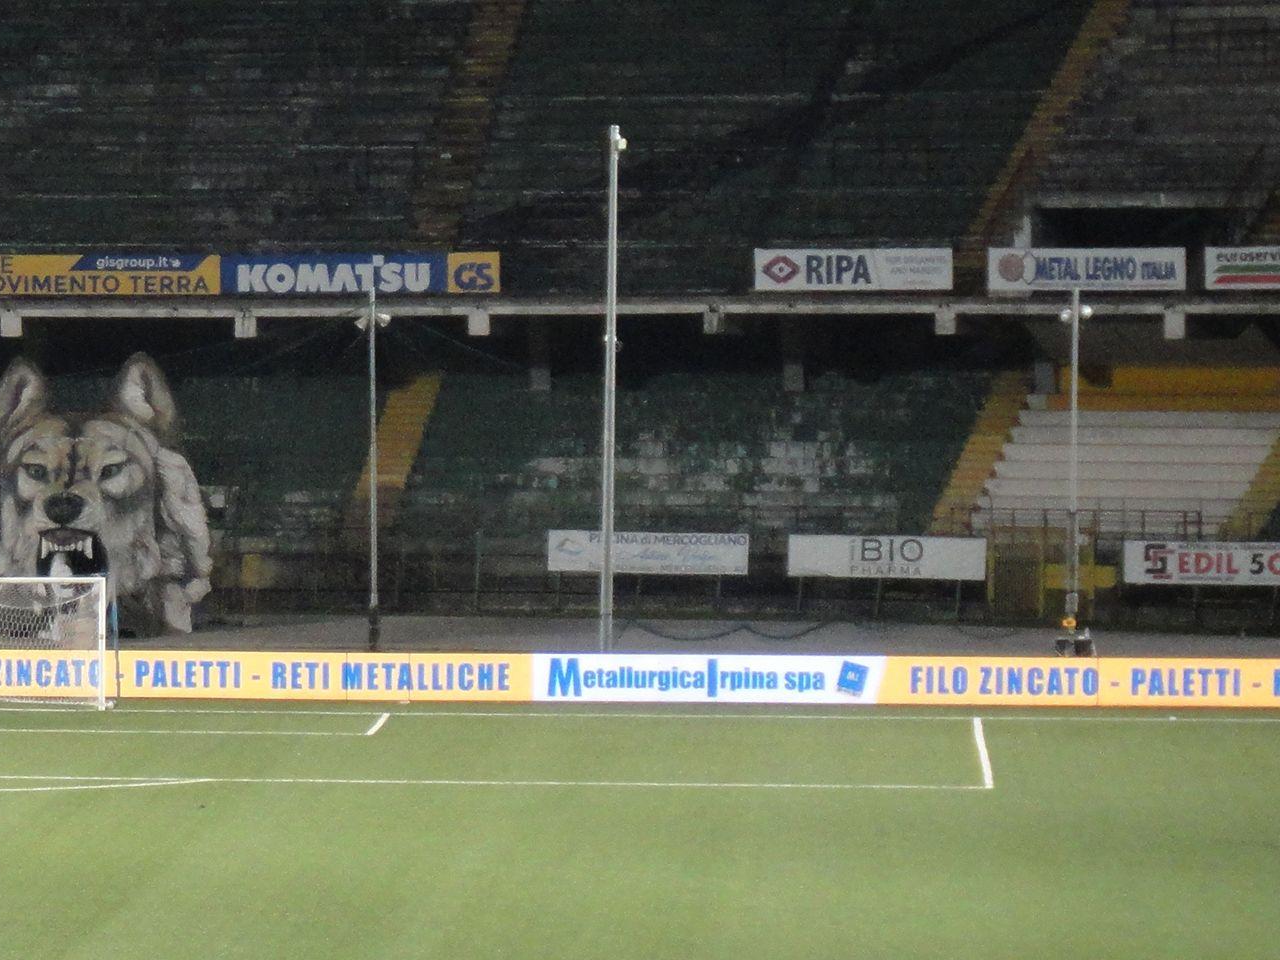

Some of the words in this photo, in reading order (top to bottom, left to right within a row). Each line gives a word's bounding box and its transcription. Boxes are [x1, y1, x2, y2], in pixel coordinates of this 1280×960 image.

[96, 256, 168, 271] gisgroup.it
[237, 255, 431, 293] KOMATSU
[806, 254, 871, 285] RIPA
[1035, 257, 1081, 281] METAL
[1085, 256, 1137, 281] LEGNO
[1141, 261, 1177, 280] ITALIA
[129, 275, 209, 293] TERRA
[589, 533, 638, 545] PIINA
[654, 534, 746, 546] MERCOGLIANO
[850, 565, 922, 577] PHARMA
[1178, 552, 1240, 575] EDIL
[135, 660, 241, 688] PALETTI
[271, 661, 330, 690] RETI
[341, 663, 510, 691] METALLICHE
[784, 671, 825, 692] spa
[910, 666, 968, 694] FILO
[979, 666, 1099, 696] ZINCATO
[1131, 668, 1241, 697] PALETTI
